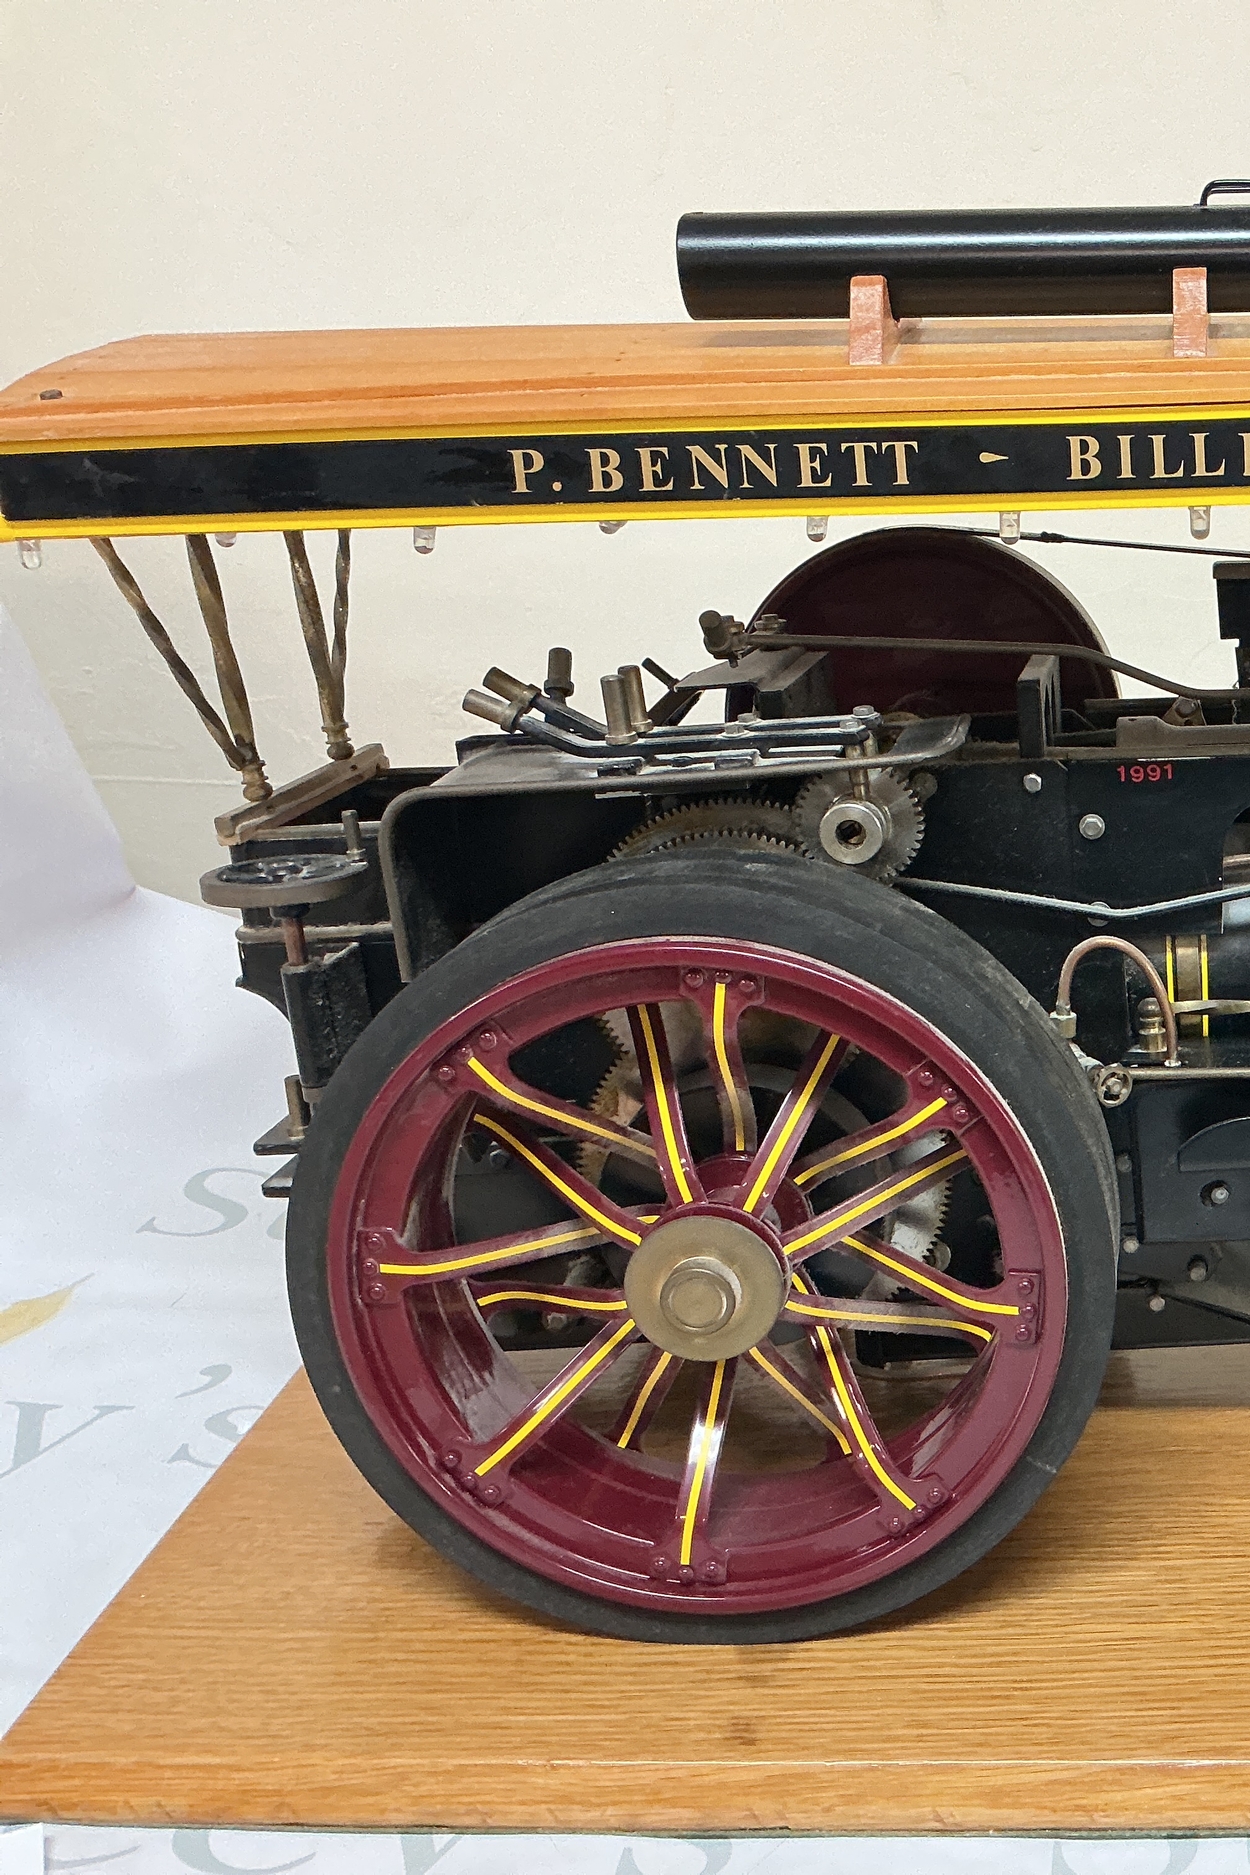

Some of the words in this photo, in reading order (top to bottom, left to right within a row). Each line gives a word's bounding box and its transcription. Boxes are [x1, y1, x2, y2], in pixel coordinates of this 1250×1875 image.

[507, 448, 563, 494] P.
[584, 440, 919, 493] BENNETT
[1116, 763, 1174, 783] 1991
